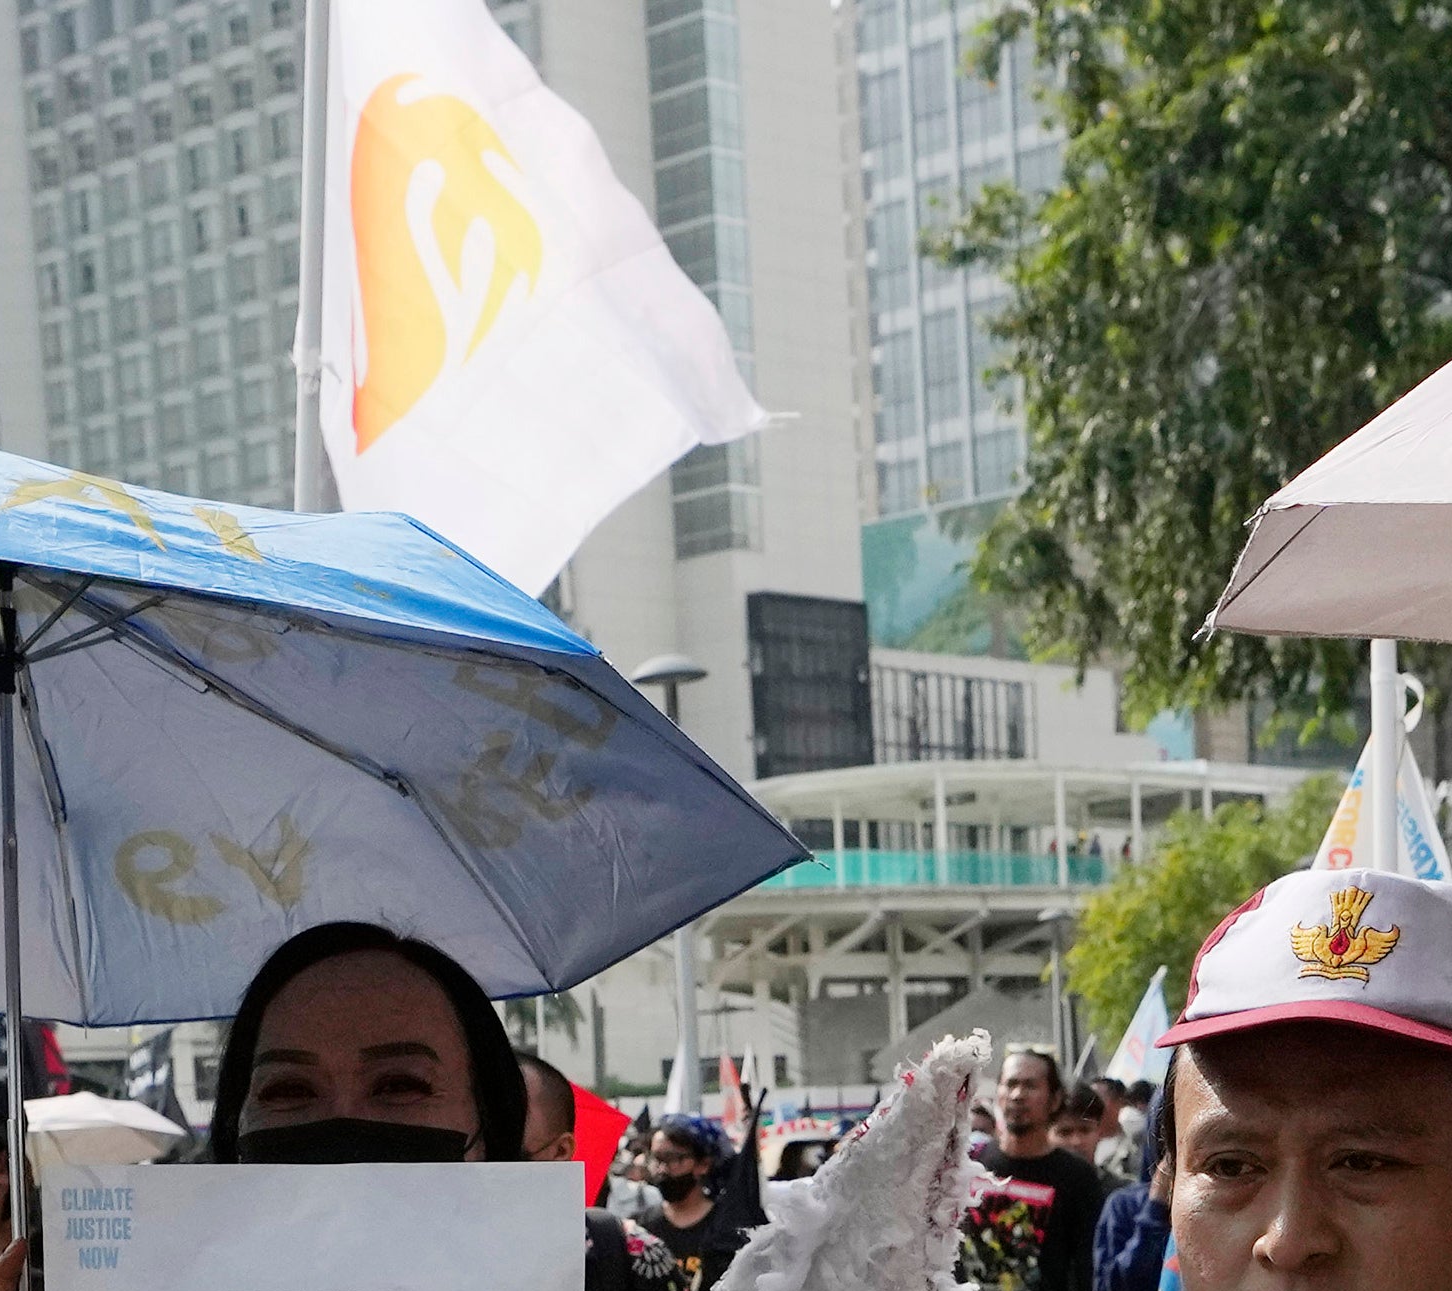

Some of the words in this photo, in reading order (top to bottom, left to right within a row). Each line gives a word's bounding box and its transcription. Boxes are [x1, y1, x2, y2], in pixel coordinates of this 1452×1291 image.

[61, 1188, 133, 1212] CLIMATE
[65, 1218, 132, 1241] JUSTICE
[78, 1247, 119, 1270] NOW
